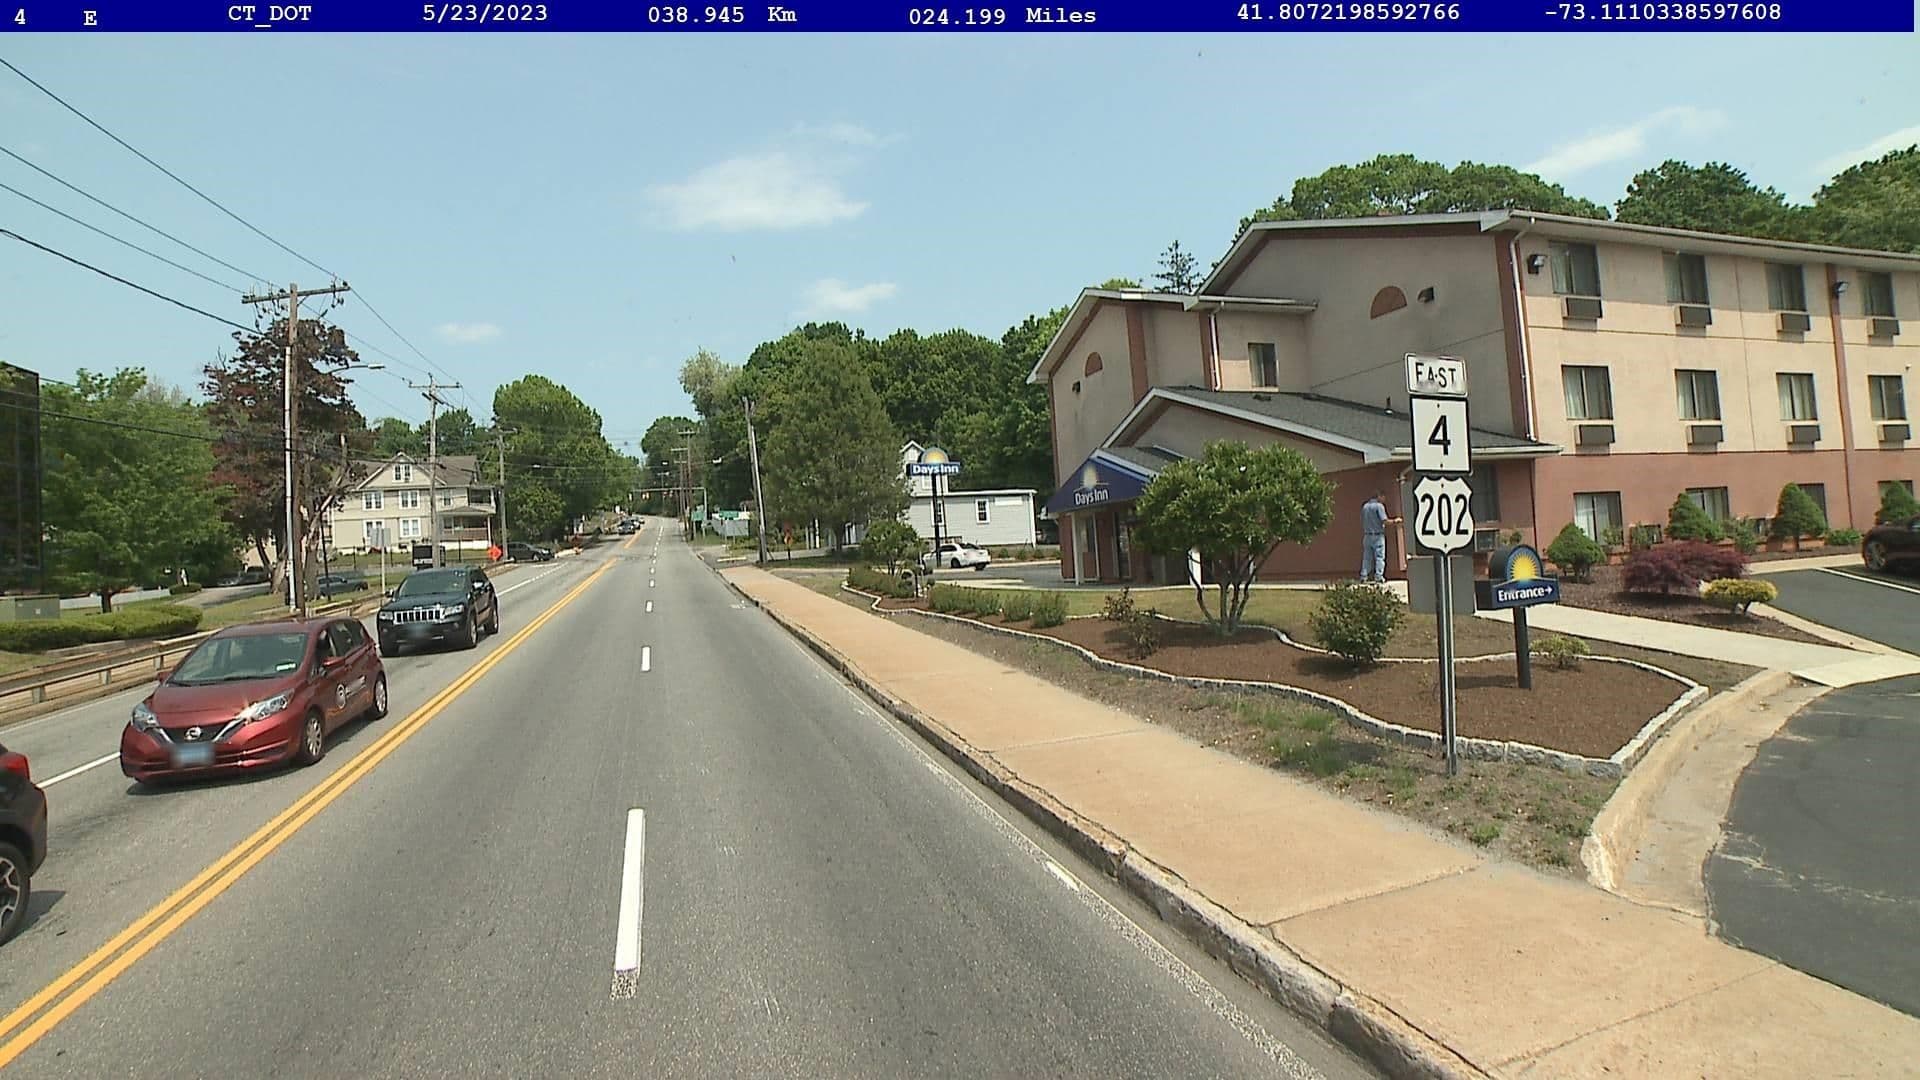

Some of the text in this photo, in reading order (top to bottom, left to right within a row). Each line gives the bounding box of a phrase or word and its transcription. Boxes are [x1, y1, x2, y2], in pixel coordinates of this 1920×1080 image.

[1428, 415, 1451, 456] 4
[912, 464, 959, 474] Days Inn
[1075, 488, 1109, 505] Days Inn
[1420, 493, 1469, 536] 202
[1498, 587, 1545, 601] Entrance
